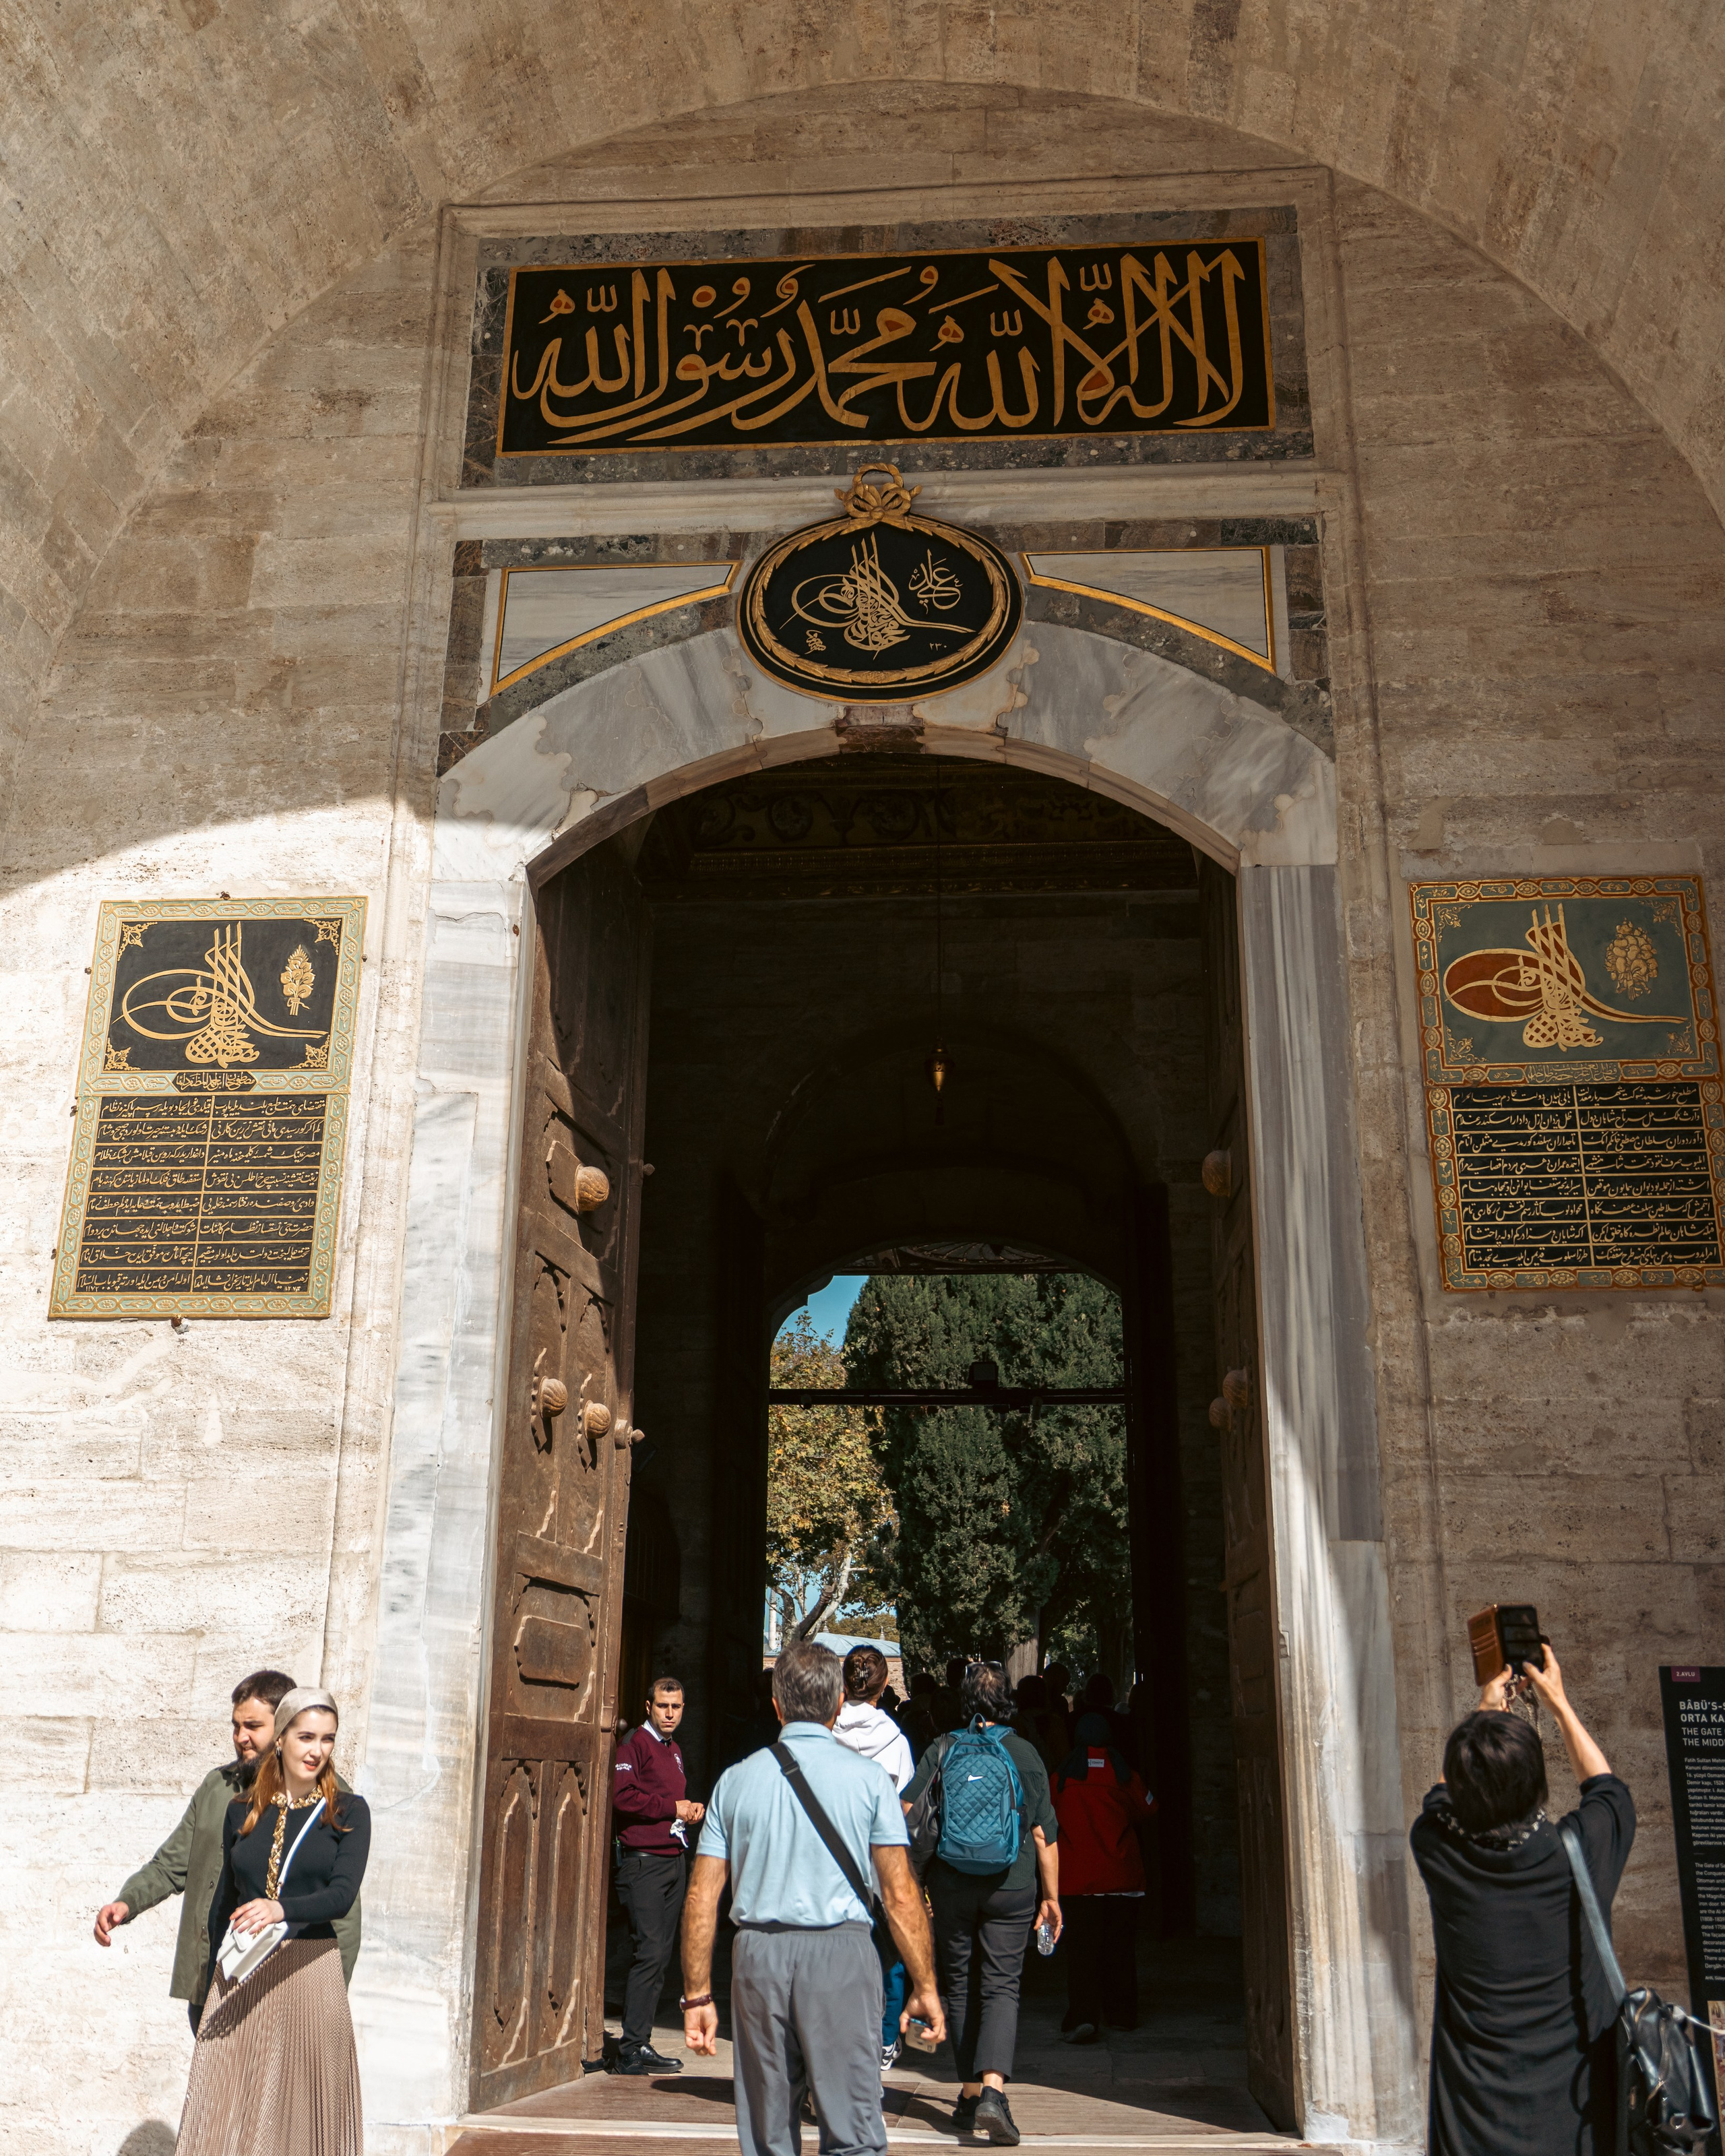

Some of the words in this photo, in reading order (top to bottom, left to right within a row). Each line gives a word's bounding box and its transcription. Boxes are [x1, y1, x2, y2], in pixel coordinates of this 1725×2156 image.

[1681, 1713, 1707, 1723] ORTA
[1682, 1727, 1698, 1736] THE
[1701, 1727, 1722, 1736] GATE
[1683, 1738, 1699, 1746] THE
